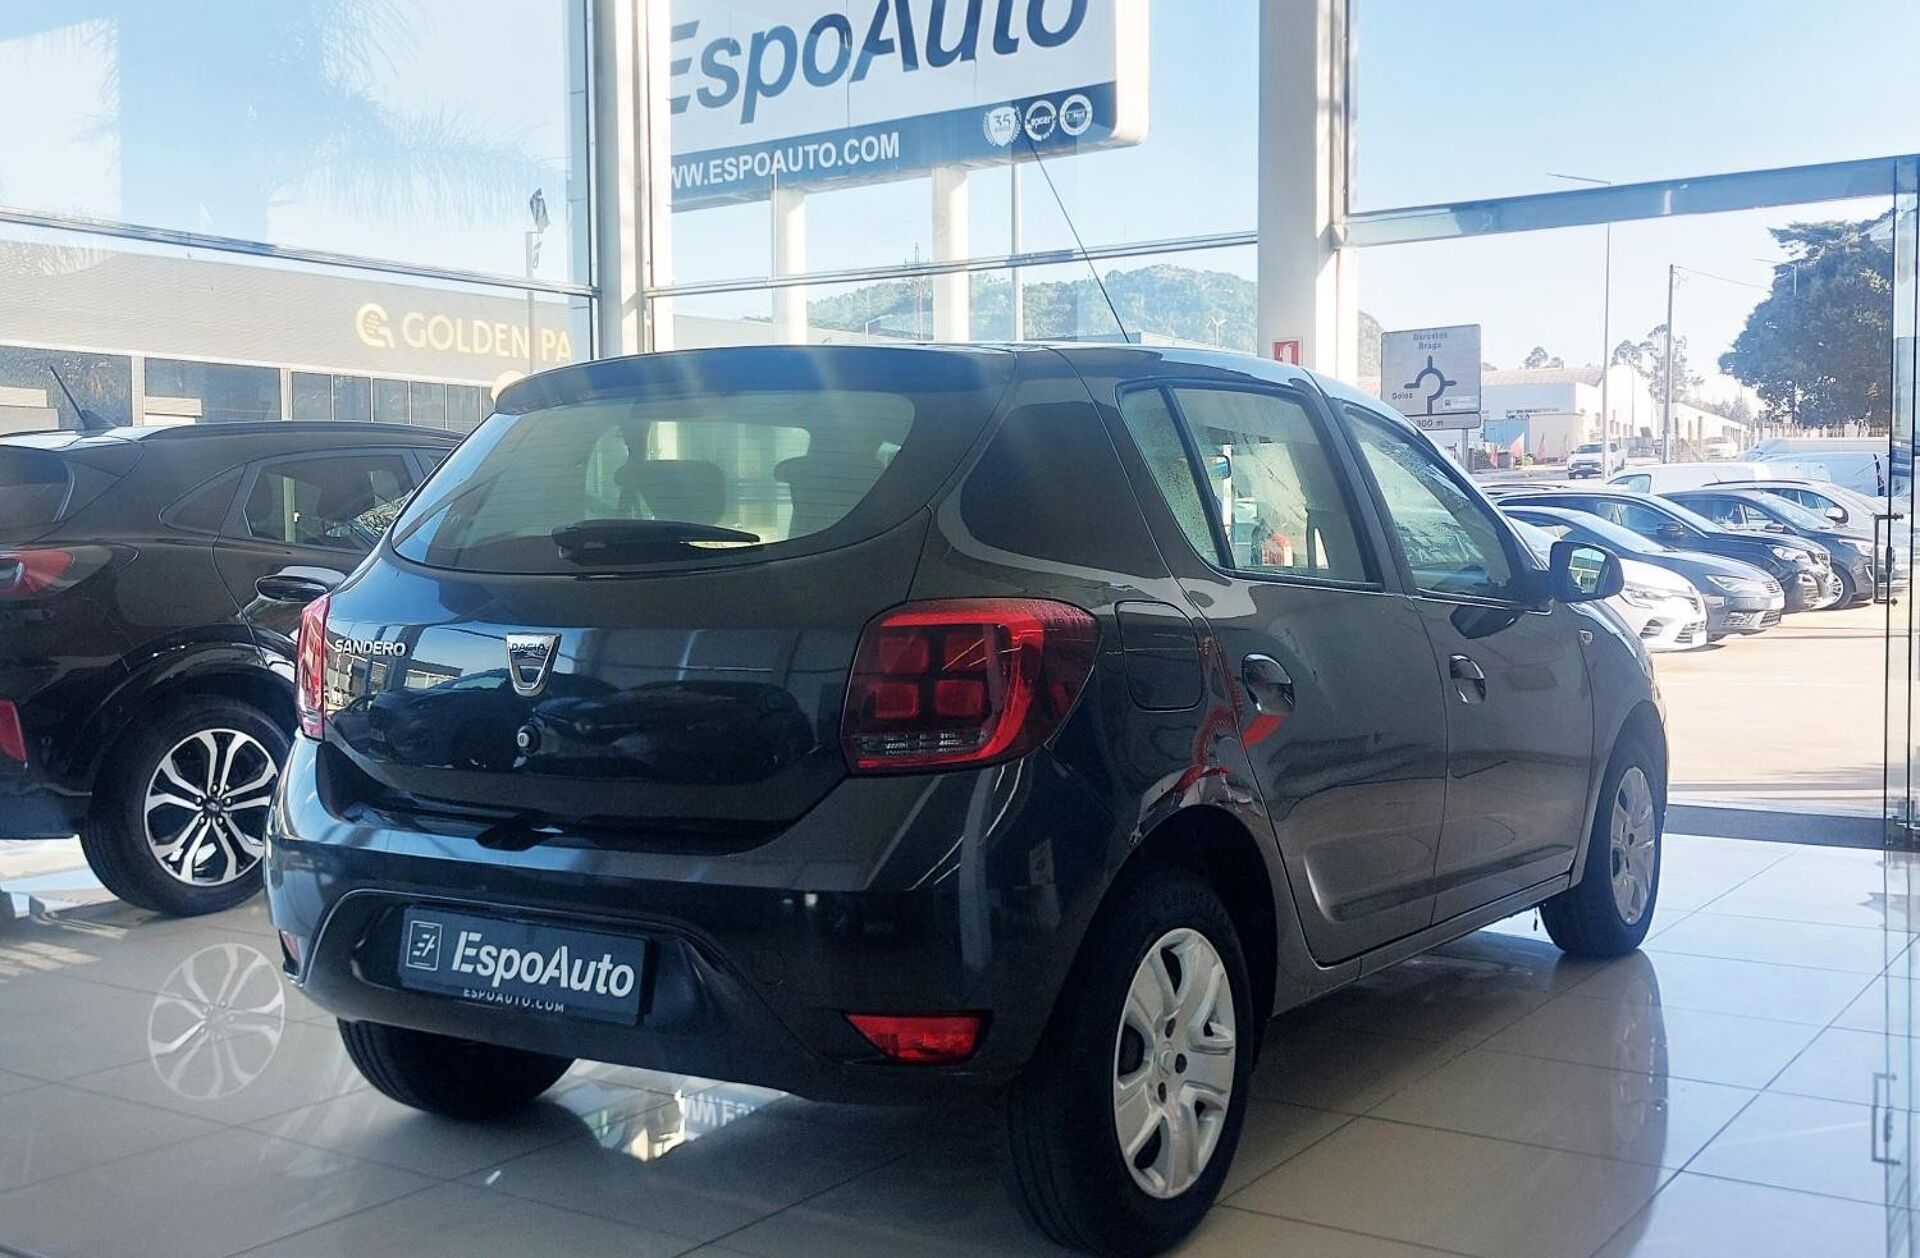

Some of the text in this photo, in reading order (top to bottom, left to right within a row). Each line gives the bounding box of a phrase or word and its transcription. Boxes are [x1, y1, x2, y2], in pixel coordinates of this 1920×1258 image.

[402, 311, 530, 359] GOLDEN
[1419, 341, 1442, 351] Braga
[334, 638, 407, 657] SANDERO
[511, 643, 546, 653] DACIA
[452, 931, 635, 998] EspoAuto
[463, 987, 564, 1013] ESPOAUTO.COM
